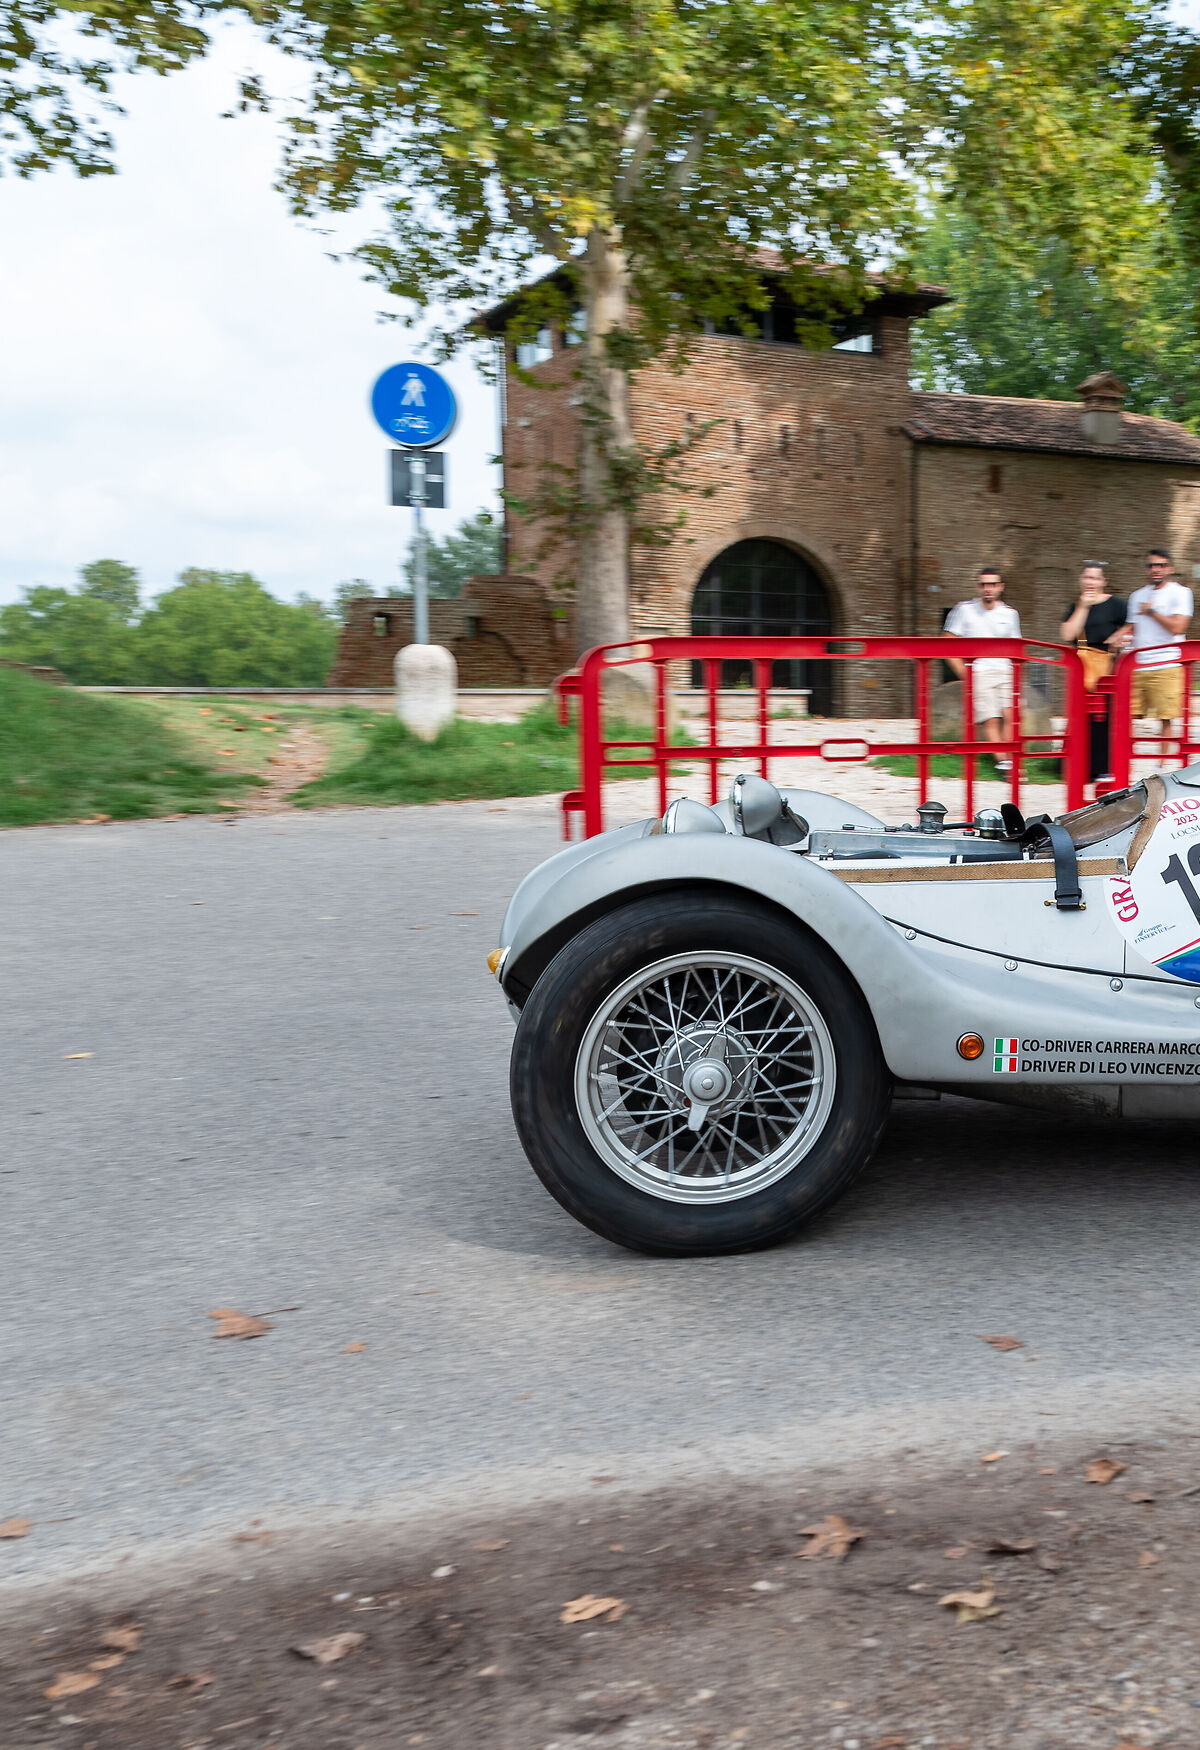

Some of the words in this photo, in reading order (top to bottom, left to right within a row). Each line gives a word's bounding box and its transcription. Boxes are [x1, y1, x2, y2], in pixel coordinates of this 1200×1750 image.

[1174, 813, 1198, 826] 2023
[1021, 1039, 1093, 1053] CO-DRIVER
[1095, 1041, 1156, 1054] CARRERA
[1021, 1059, 1076, 1073] DRIVER
[1079, 1061, 1095, 1074] DI
[1098, 1061, 1127, 1075] LEO
